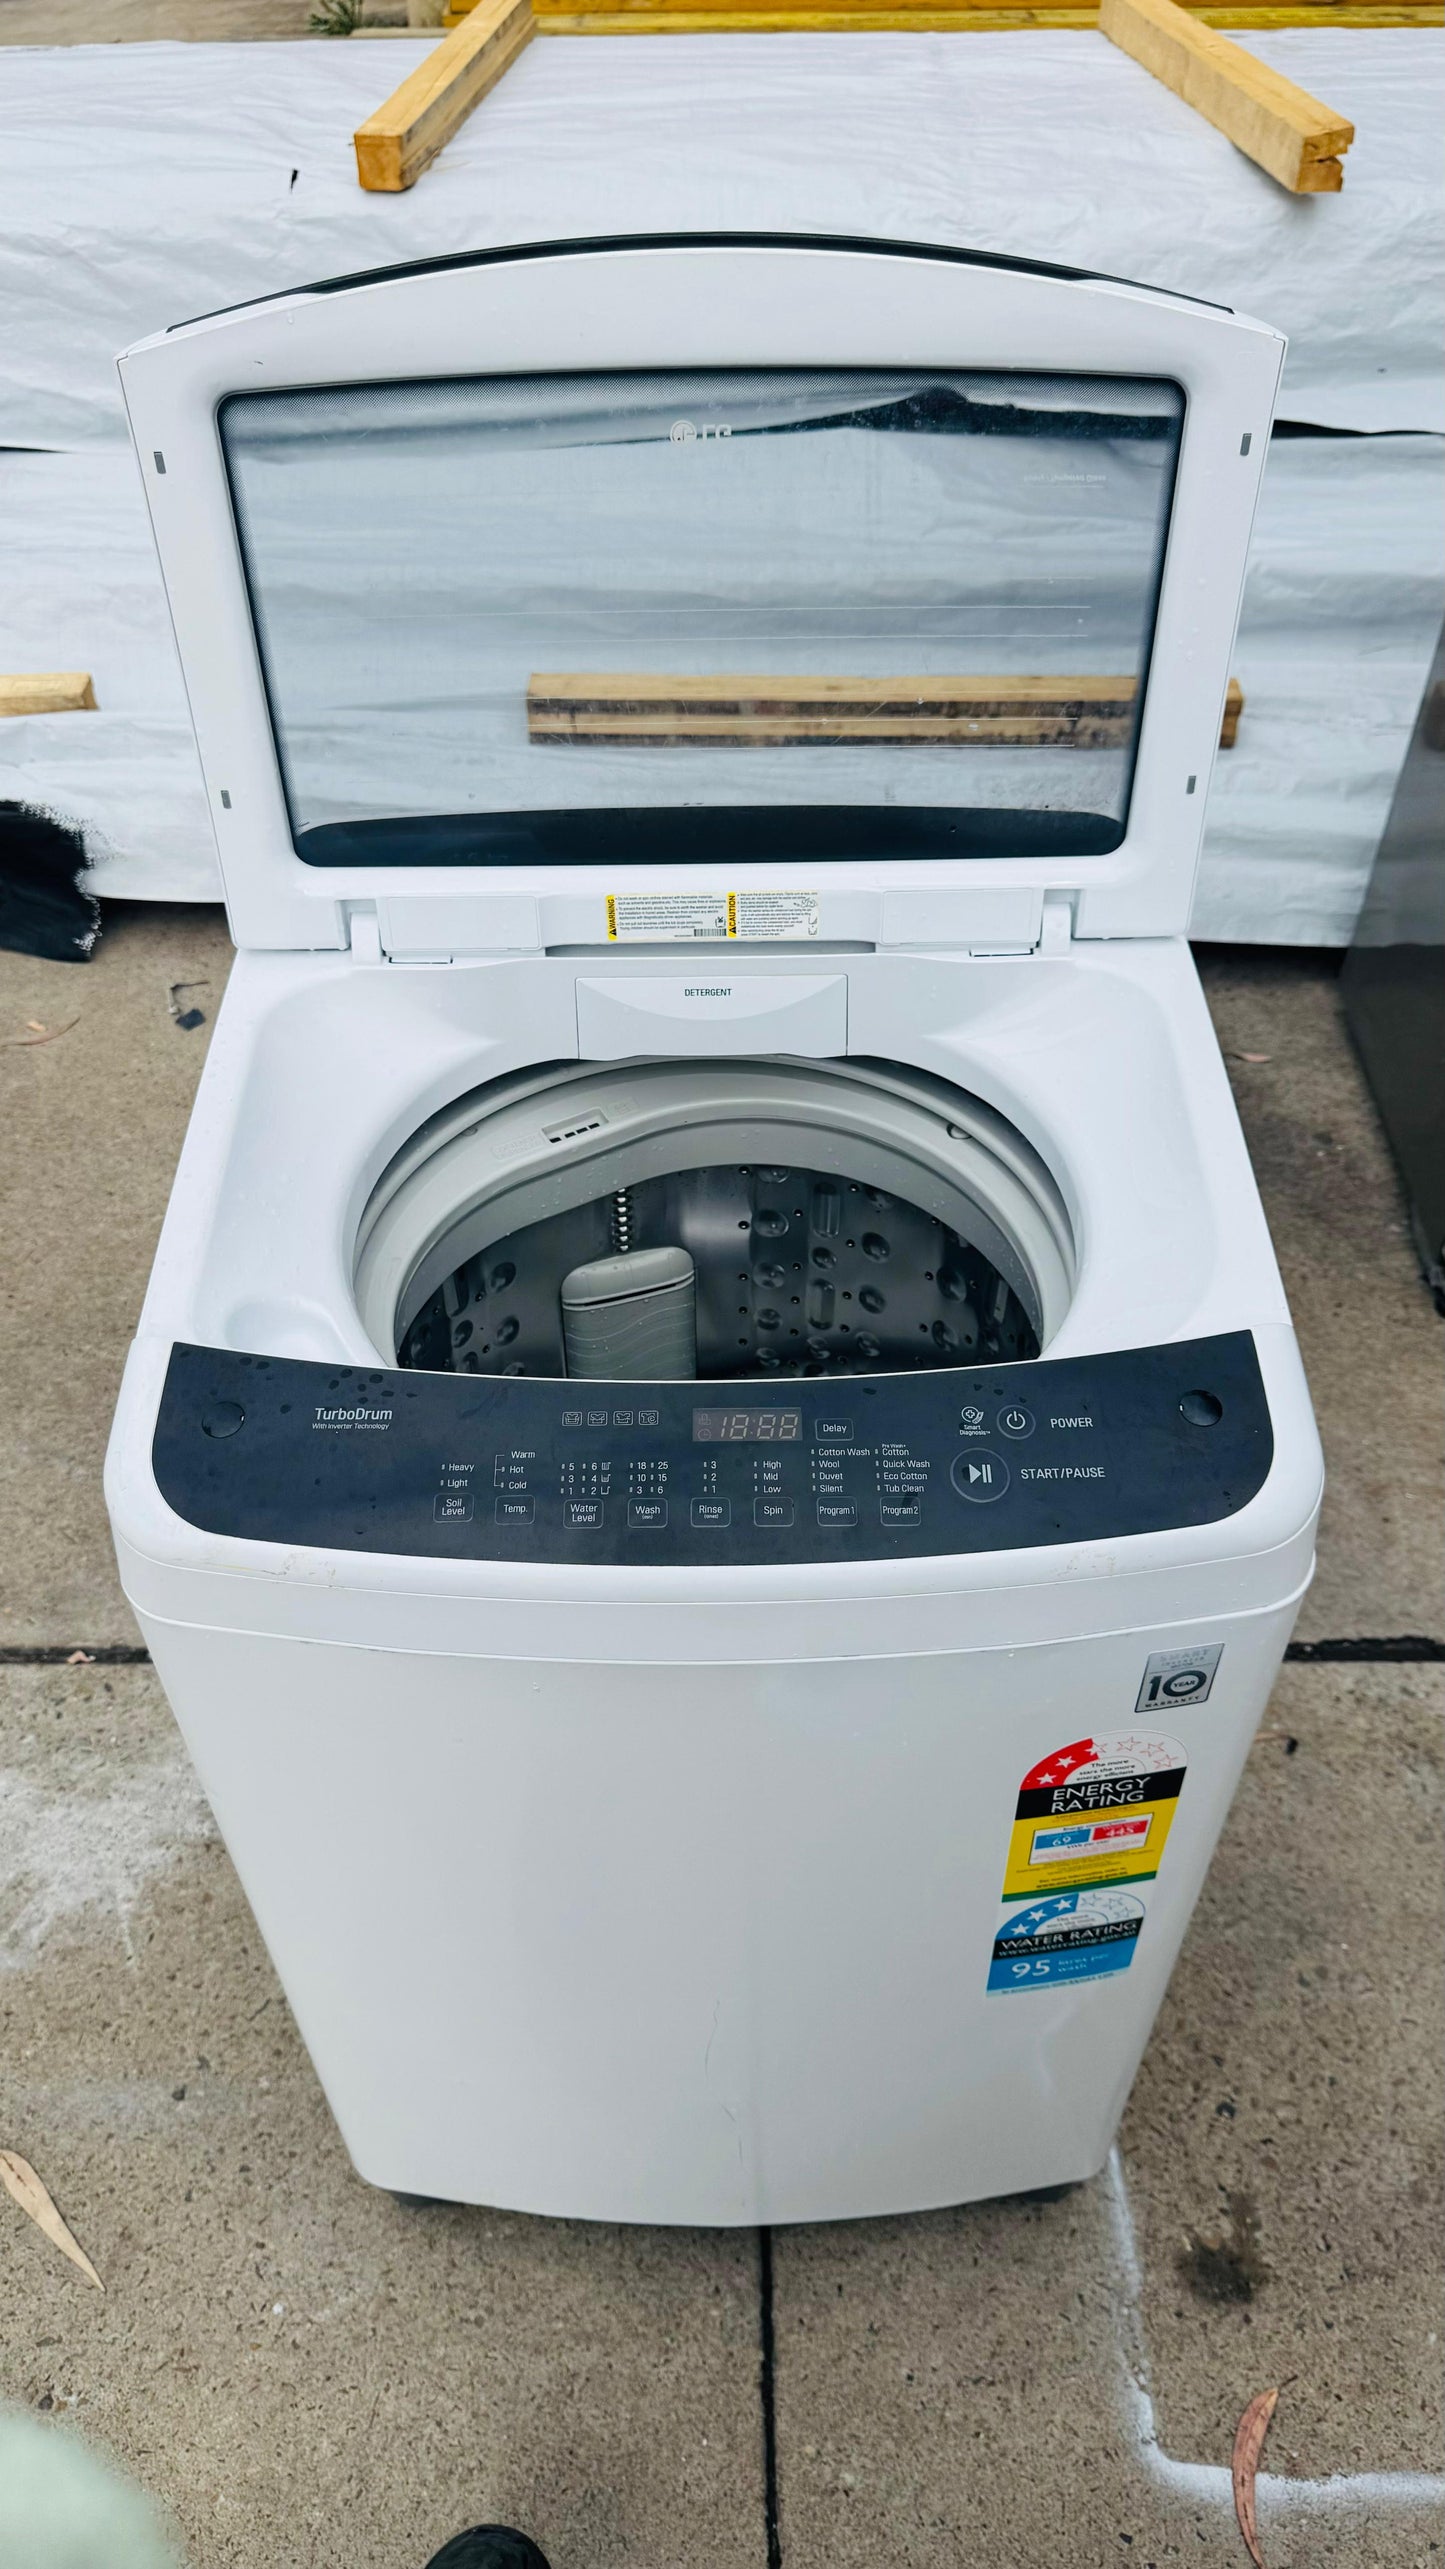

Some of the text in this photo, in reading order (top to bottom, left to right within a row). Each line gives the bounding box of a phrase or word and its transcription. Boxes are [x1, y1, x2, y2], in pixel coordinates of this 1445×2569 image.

[607, 898, 616, 929] WARNING
[728, 895, 737, 926] CAUTION
[684, 988, 732, 997] DETERGENT
[315, 1407, 393, 1420] TurboDrum
[312, 1422, 390, 1431] With Inverter Technology
[1050, 1417, 1094, 1429] POWER
[822, 1423, 847, 1433] Delay
[511, 1450, 536, 1459] Warm
[818, 1448, 871, 1456] Cotton Wash
[881, 1448, 910, 1456] Cotton
[448, 1463, 476, 1473] Heavy
[568, 1463, 598, 1471] 5 6
[637, 1461, 669, 1470] 18 25
[710, 1460, 717, 1469] 3
[763, 1460, 782, 1470] High
[819, 1460, 840, 1468] Wool
[882, 1460, 931, 1469] Quick Wash
[509, 1465, 525, 1474] Hot
[1021, 1466, 1106, 1480] START/PAUSE
[568, 1474, 598, 1483] 3 4
[637, 1473, 668, 1482] 10 15
[710, 1472, 717, 1481] 2
[763, 1472, 779, 1481] Mid
[819, 1472, 843, 1480] Duvet
[883, 1472, 928, 1480] Eco Cotton
[447, 1479, 469, 1489] Light
[508, 1481, 528, 1490] Cold
[763, 1484, 782, 1493] Low
[819, 1484, 844, 1493] Silent
[885, 1484, 925, 1493] Tub Clean
[568, 1486, 597, 1495] 1 2
[636, 1485, 664, 1494] 3 6
[711, 1485, 717, 1494] 1
[446, 1498, 463, 1508] Soil
[441, 1507, 466, 1516] Level
[504, 1504, 528, 1514] Temp.
[570, 1503, 598, 1513] Water
[635, 1505, 661, 1515] Wash
[699, 1504, 723, 1514] Rinse
[763, 1505, 783, 1516] Spin
[571, 1513, 596, 1522] Level
[1148, 1669, 1207, 1701] 10
[1173, 1680, 1196, 1688] YEAR
[1052, 1776, 1151, 1800] ENERGY
[1051, 1790, 1145, 1813] RATING
[1052, 1835, 1072, 1847] 69
[1001, 1933, 1064, 1950] WATER
[1070, 1920, 1137, 1940] RATING
[1011, 1959, 1051, 1979] 95
